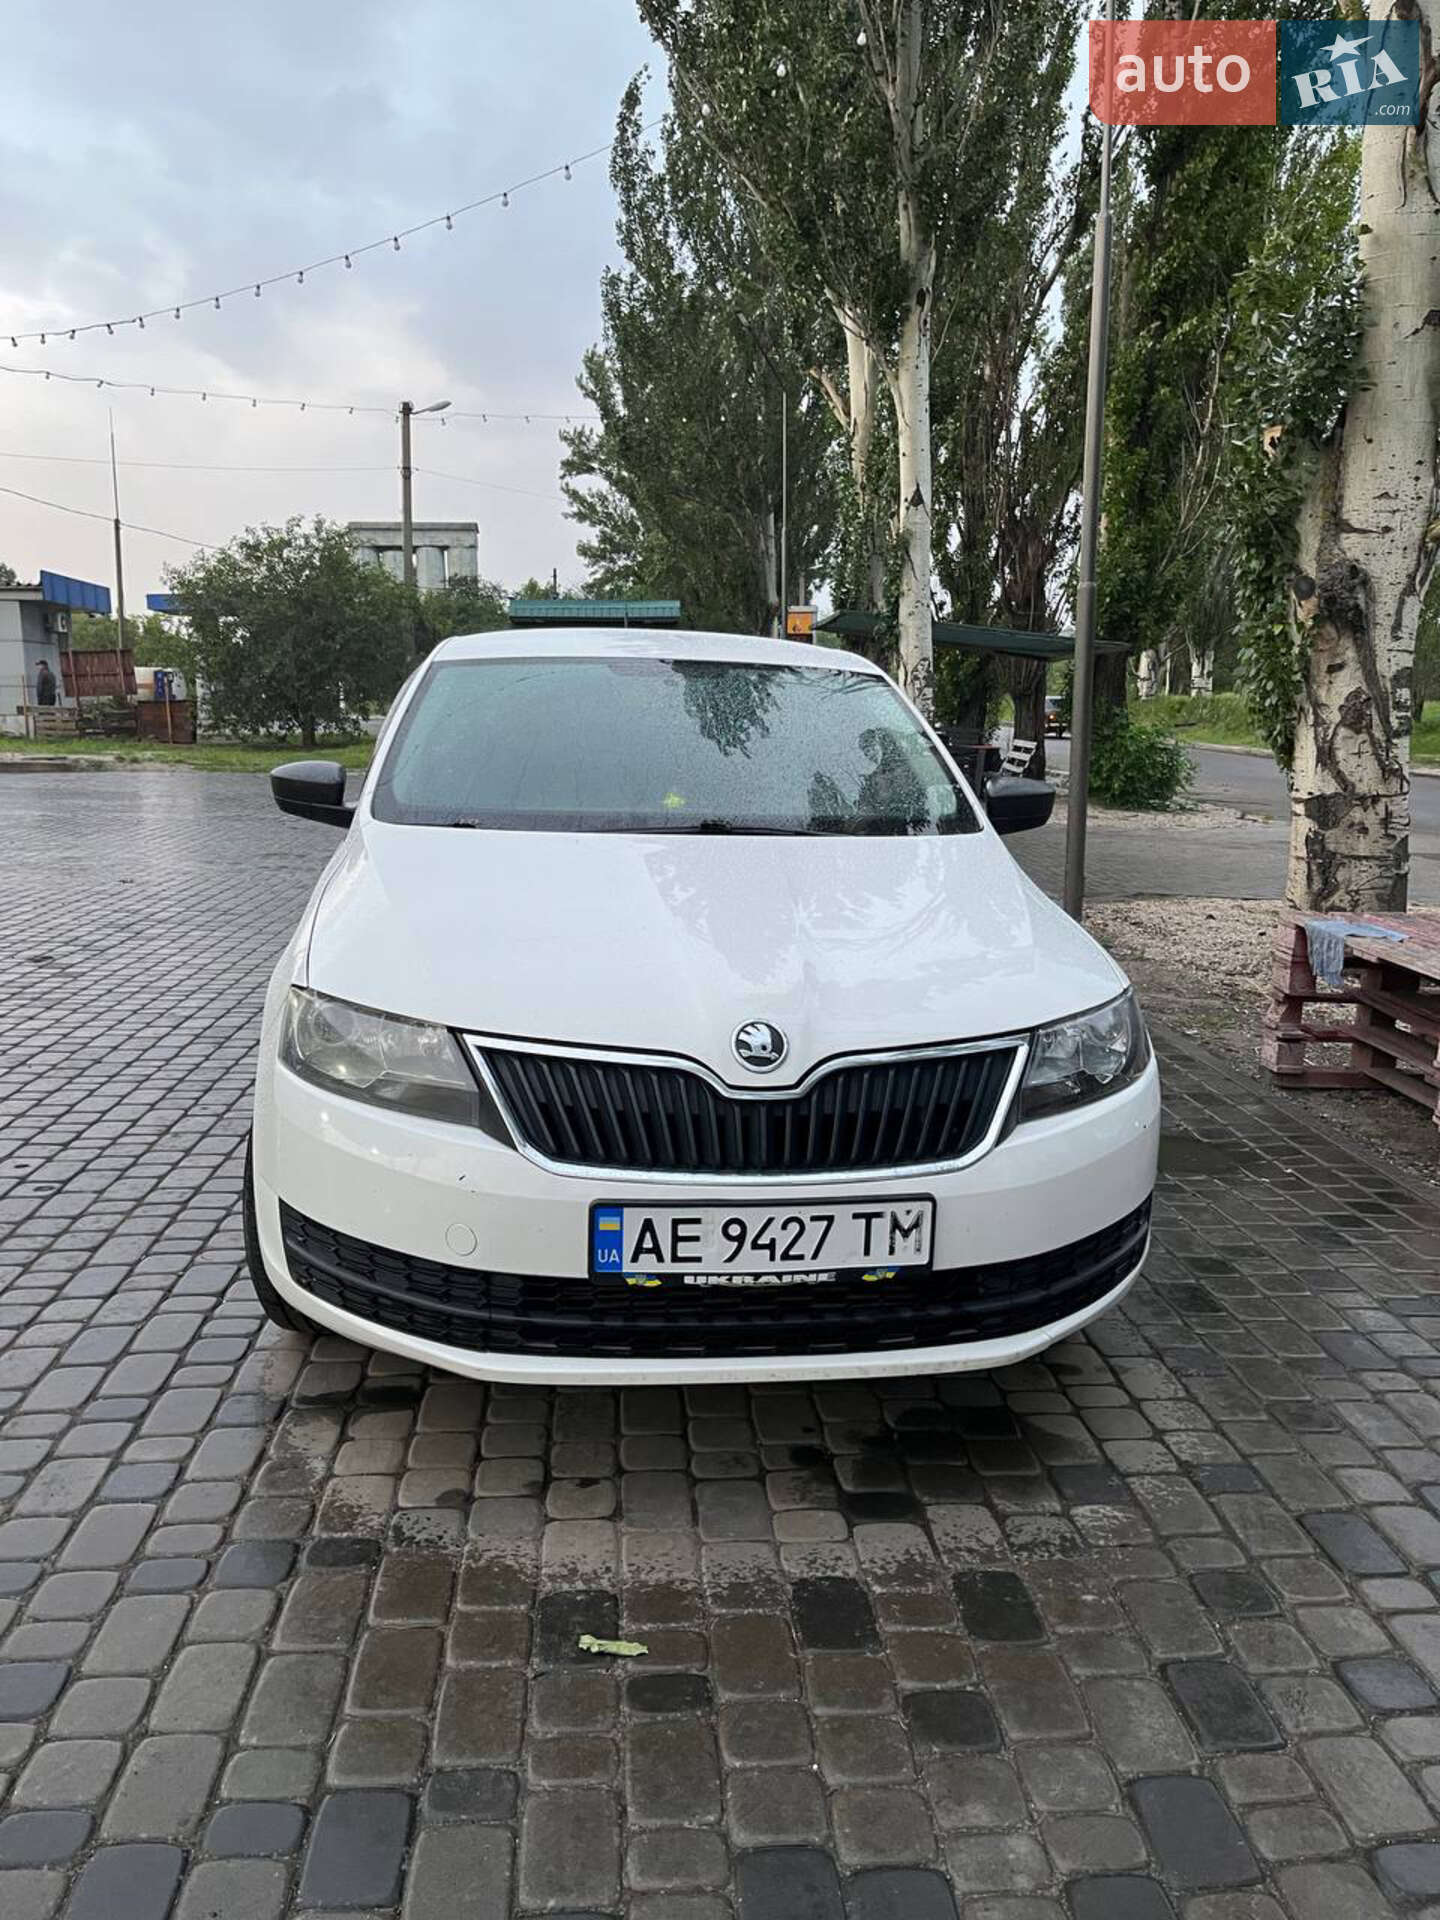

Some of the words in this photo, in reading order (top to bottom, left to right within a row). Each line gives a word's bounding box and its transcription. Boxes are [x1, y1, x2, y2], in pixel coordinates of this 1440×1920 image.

[630, 1217, 703, 1264] AE
[720, 1213, 836, 1264] 9427
[851, 1210, 924, 1257] TM
[597, 1248, 620, 1263] UA
[683, 1272, 837, 1287] UKRAINE
